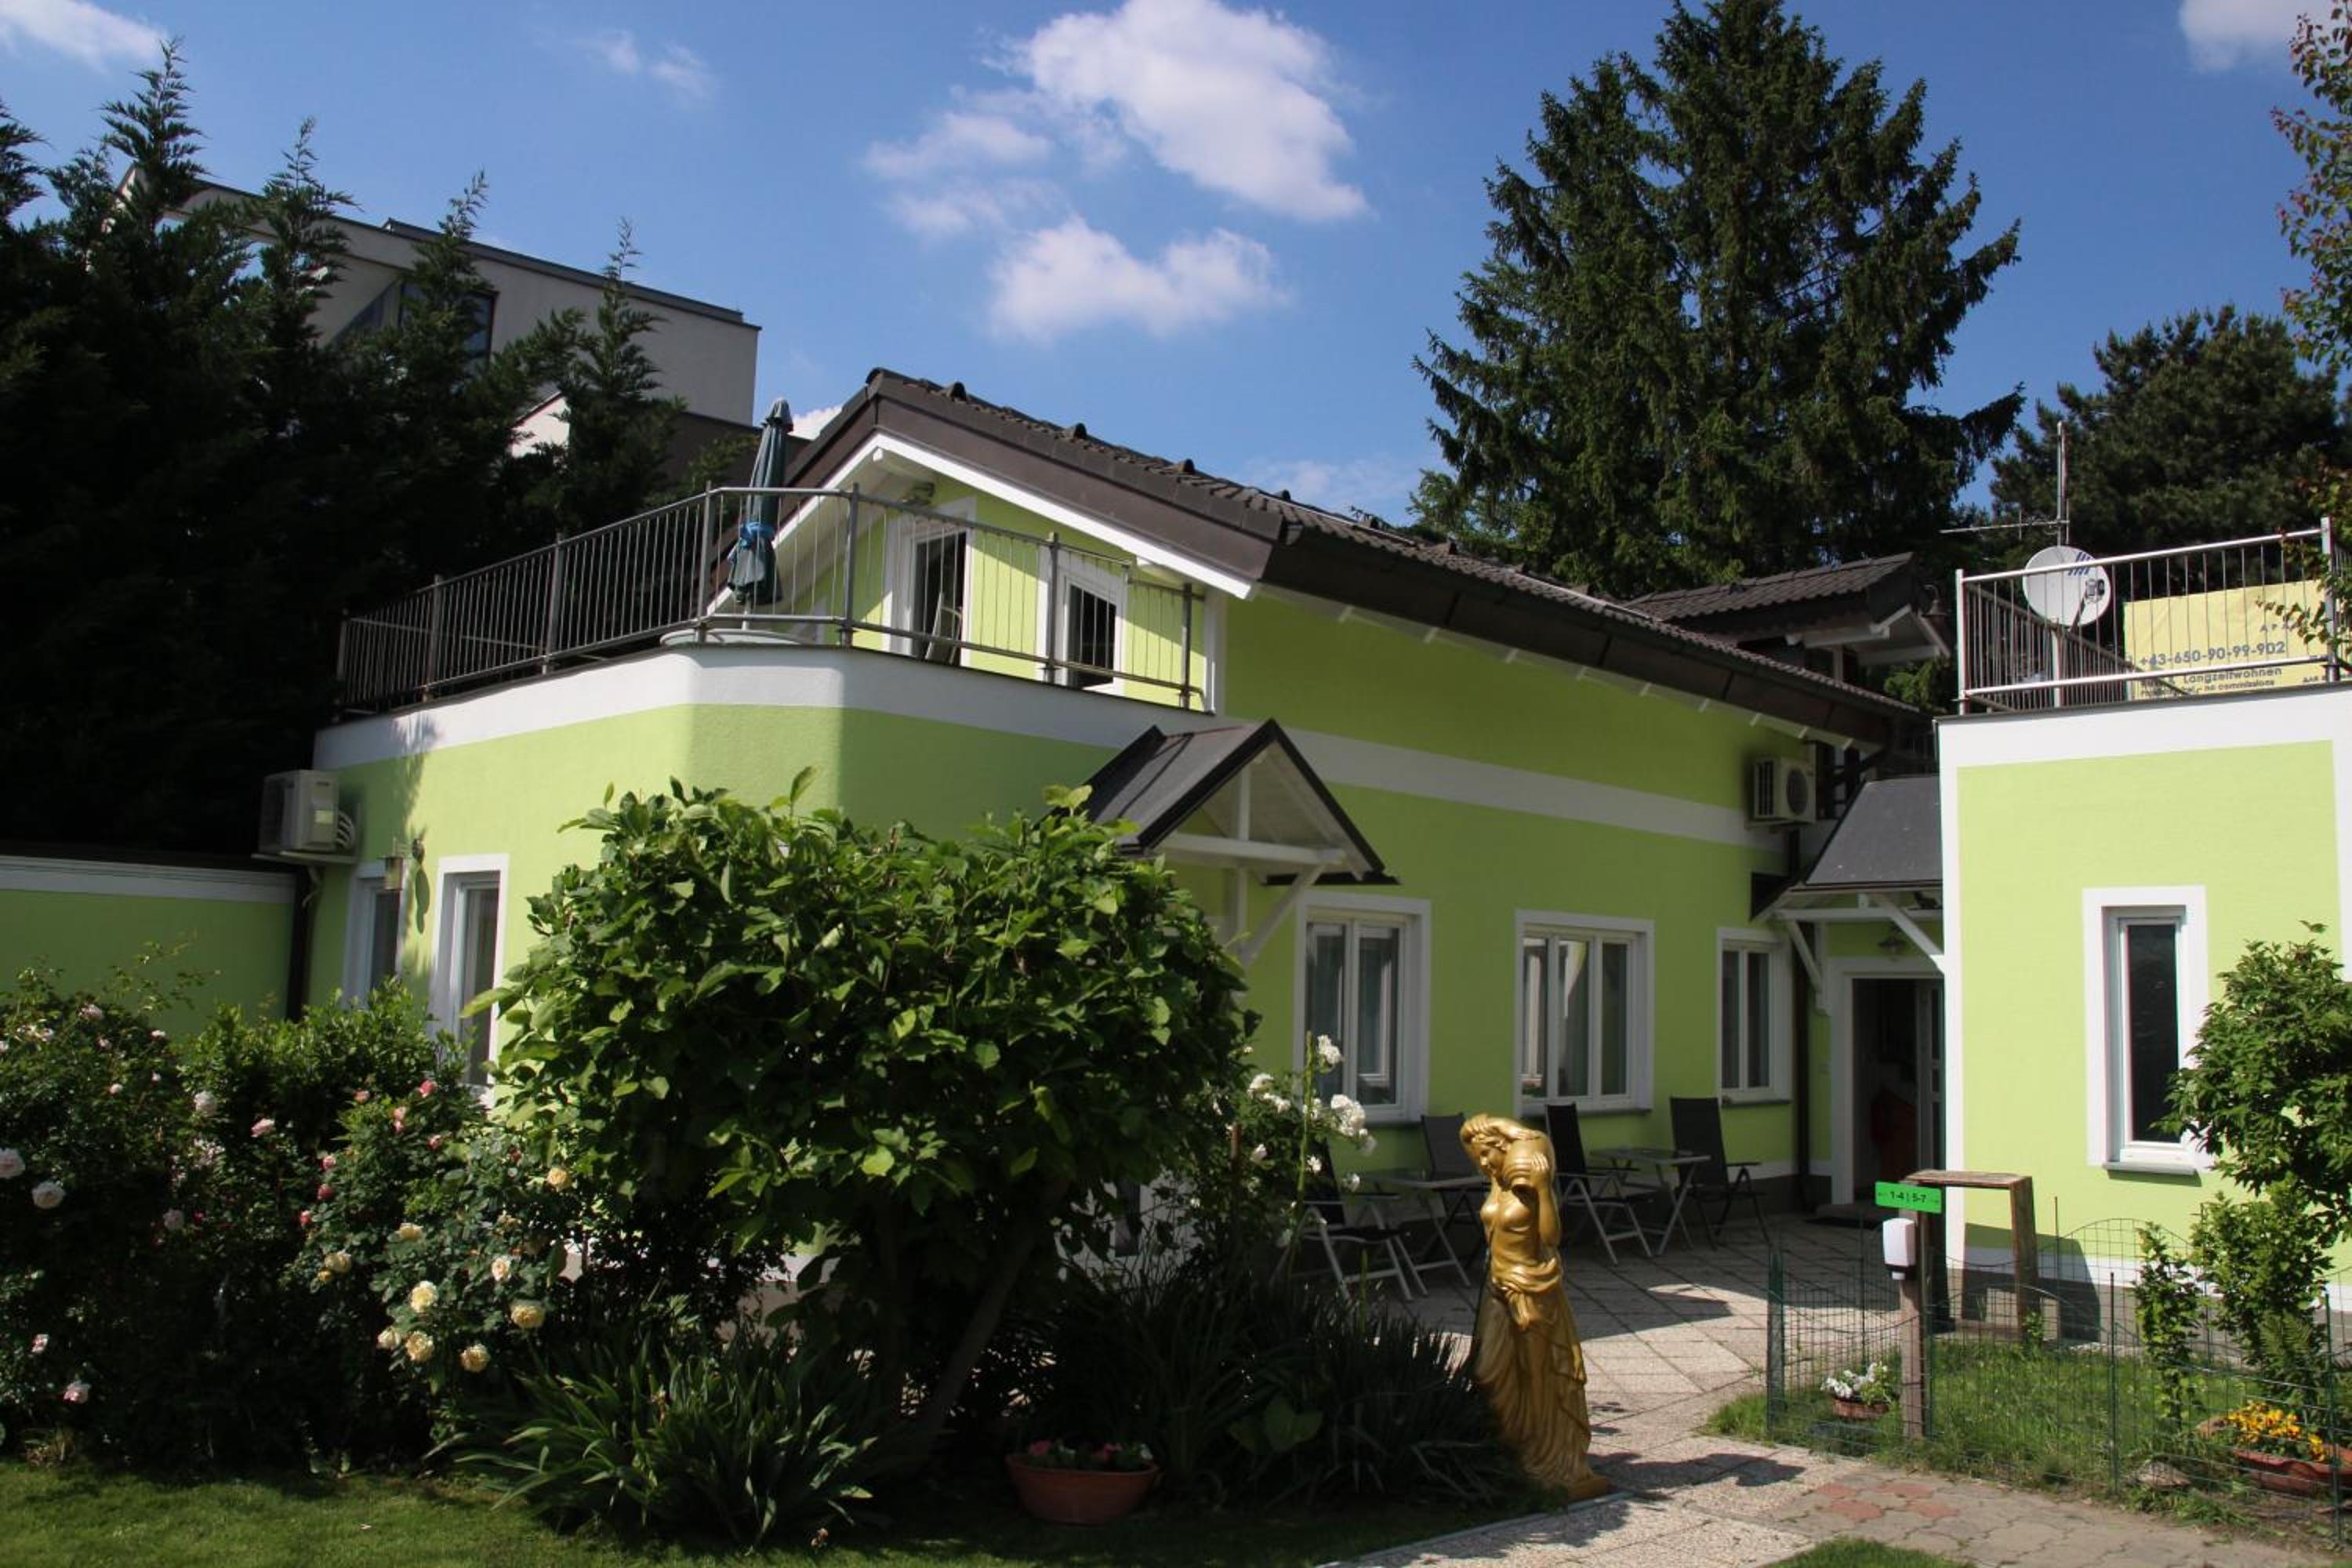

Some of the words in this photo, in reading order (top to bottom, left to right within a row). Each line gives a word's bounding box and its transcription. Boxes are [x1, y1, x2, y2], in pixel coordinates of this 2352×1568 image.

[2140, 641, 2285, 666] +43-650-90-99-902
[1889, 1191, 1904, 1200] 1-4
[1912, 1192, 1926, 1203] 5-7
